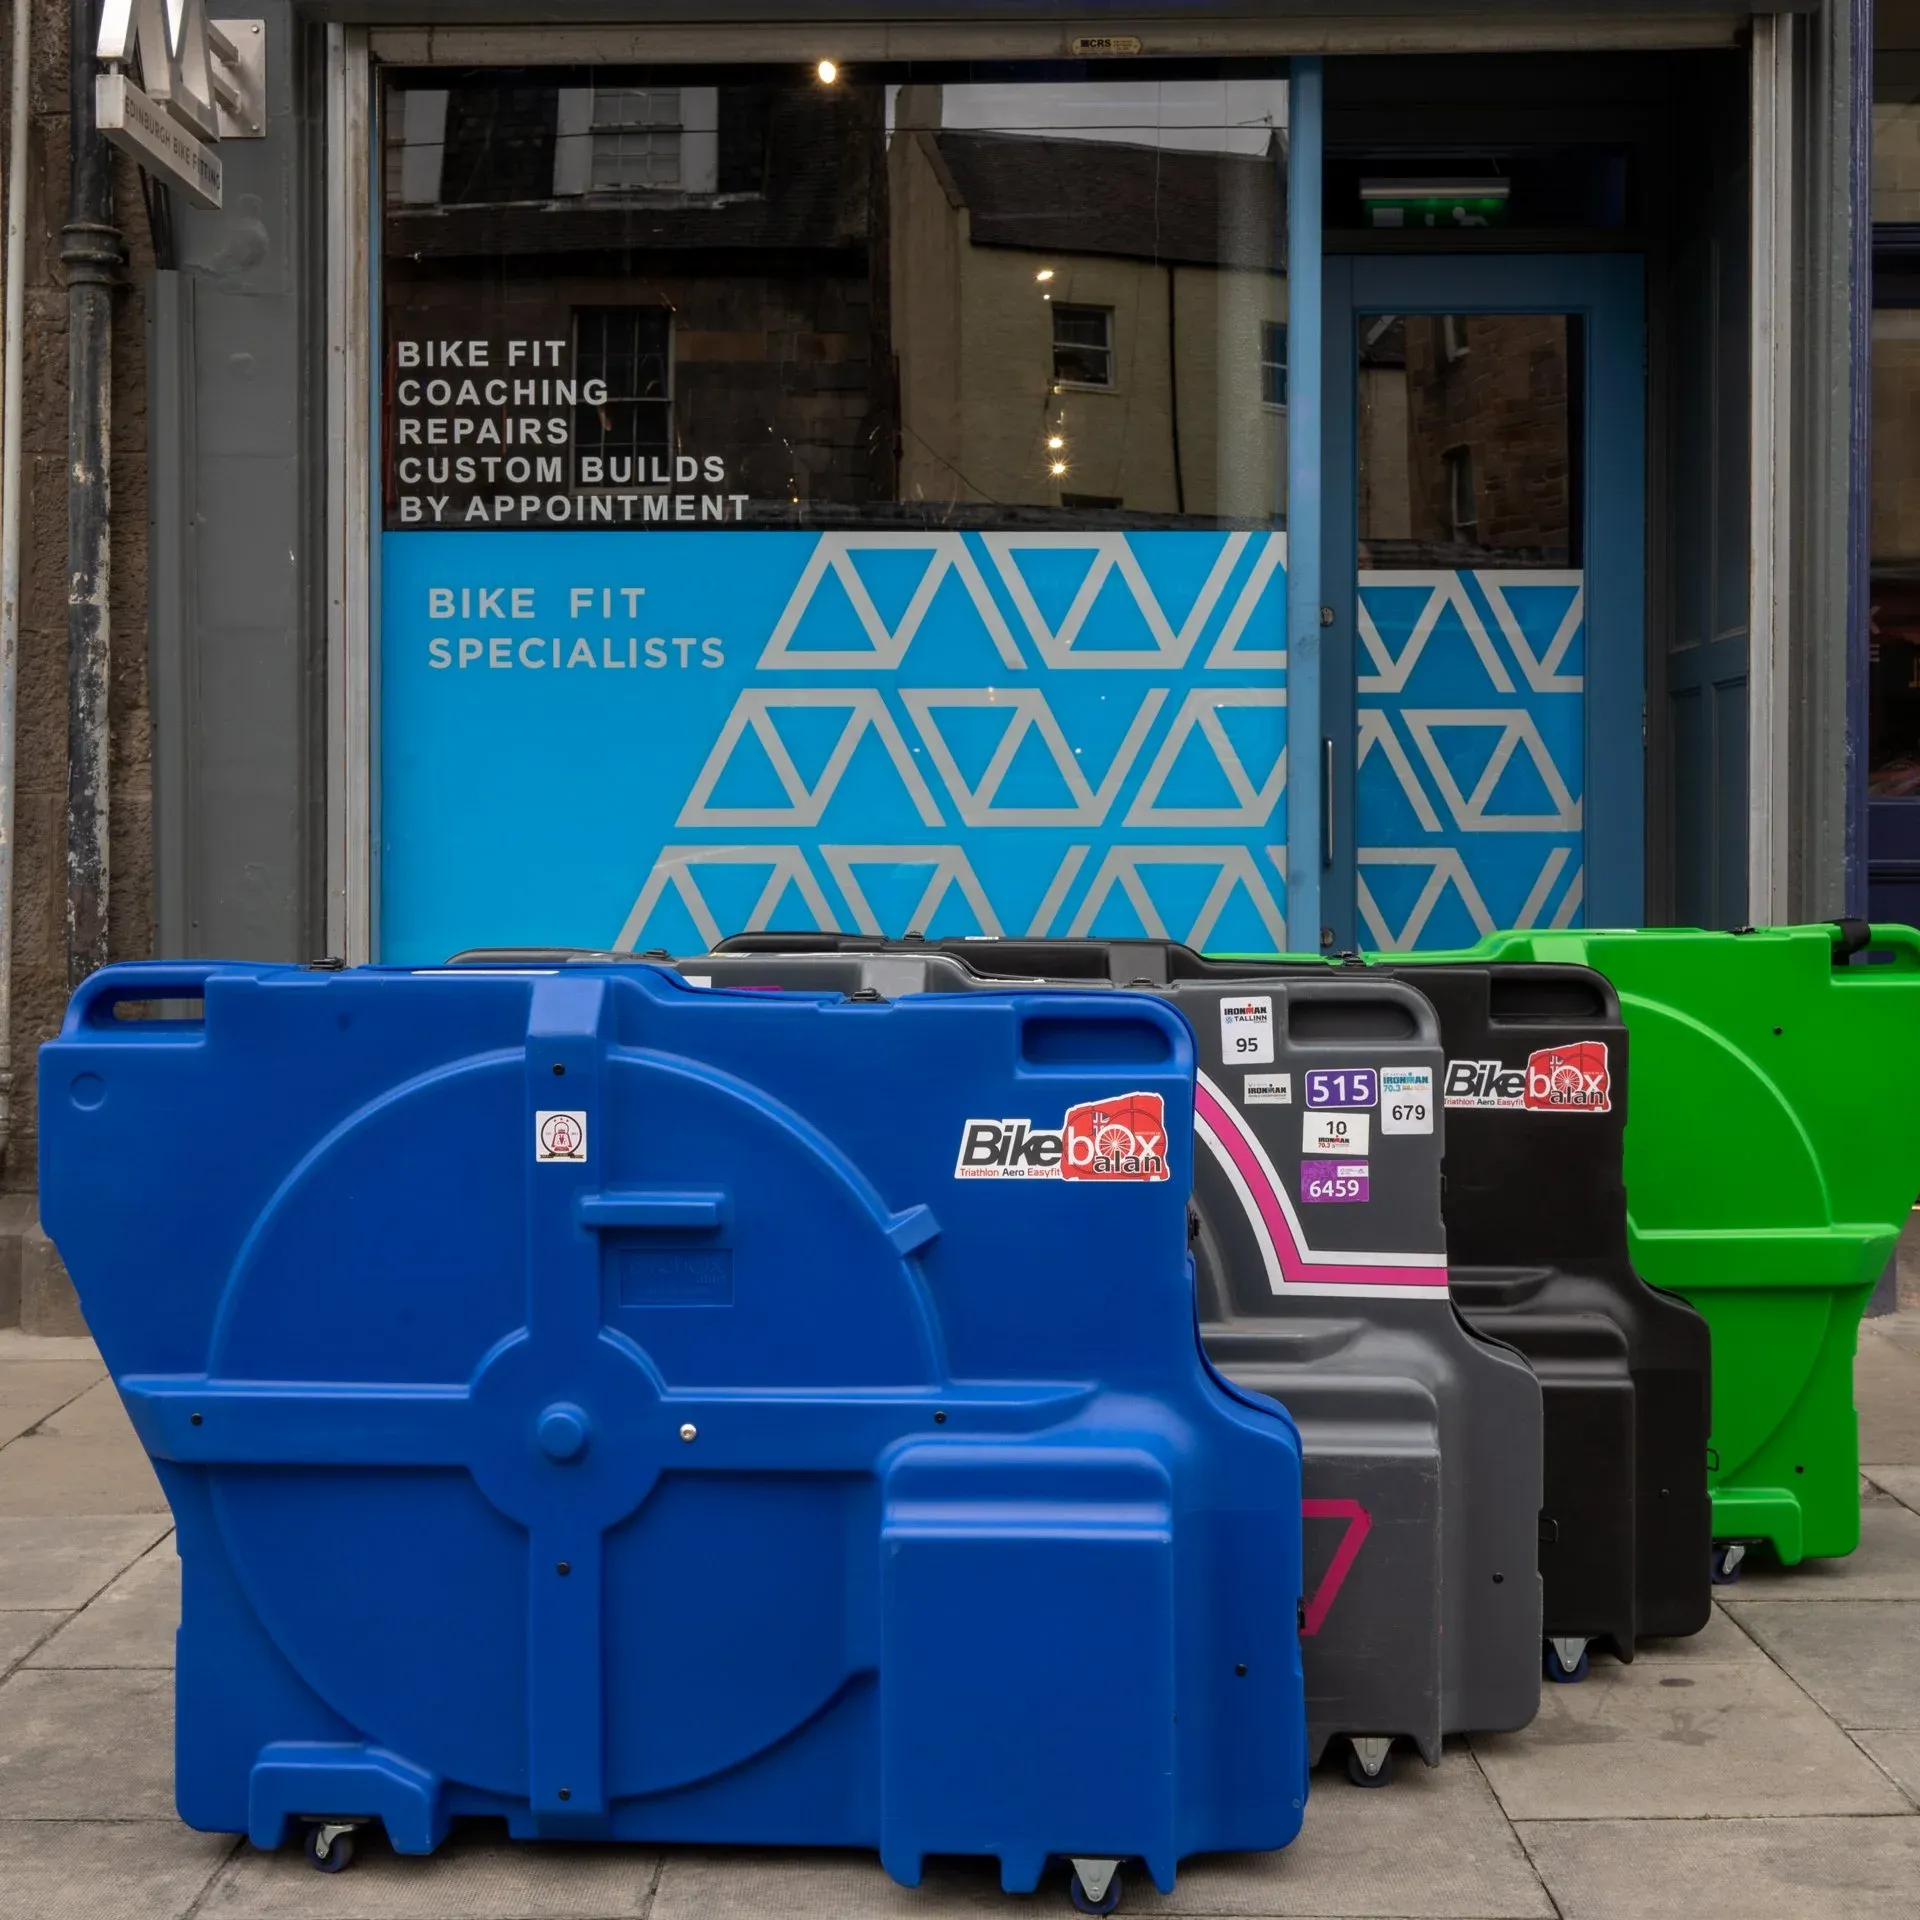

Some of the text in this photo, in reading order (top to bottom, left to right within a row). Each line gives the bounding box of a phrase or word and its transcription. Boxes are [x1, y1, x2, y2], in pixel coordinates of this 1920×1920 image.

[1089, 39, 1111, 48] CRS
[125, 94, 220, 190] EDINBURGH BIKE FITTING
[397, 340, 566, 367] BIKE FIT
[398, 379, 608, 406] COACHING
[399, 418, 569, 445] REPAIRS
[399, 456, 725, 483] CUSTOM BUILDS
[400, 495, 749, 522] BY APPOINTMENT
[428, 587, 645, 618] BIKE FIT
[428, 637, 725, 669] SPECIALISTS
[1224, 1003, 1267, 1016] IRONMAN
[1236, 1038, 1258, 1052] 95
[1383, 1072, 1429, 1084] IRONMAN
[1248, 1083, 1287, 1094] IRONMAN
[1312, 1075, 1369, 1102] 515
[1383, 1084, 1401, 1092] 70.3
[1550, 1086, 1604, 1105] alan
[1477, 1098, 1495, 1106] Aero
[1497, 1098, 1524, 1107] Easyfit
[1392, 1105, 1425, 1120] 679
[1326, 1121, 1347, 1135] 10
[1318, 1135, 1350, 1144] IRONMAN
[1093, 1150, 1162, 1174] alan
[960, 1168, 1060, 1178] Triathlon Aero Easyfit
[1309, 1180, 1360, 1198] 6459
